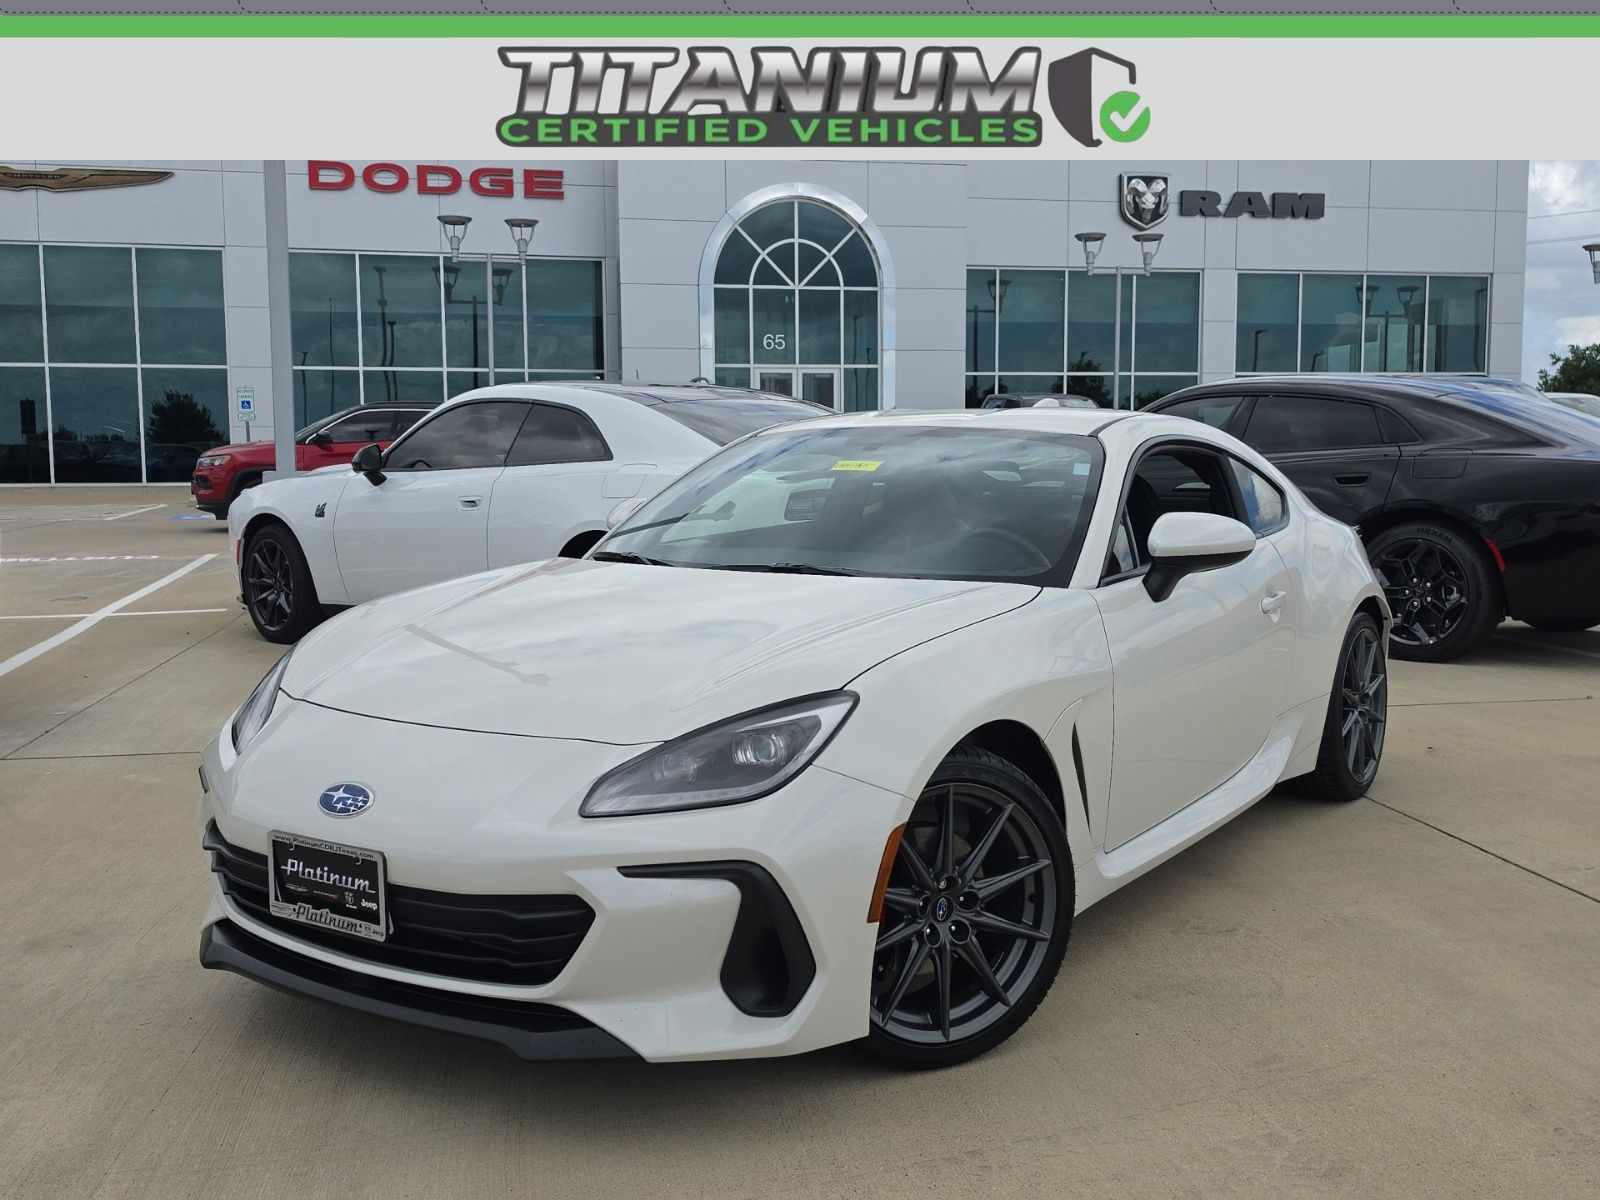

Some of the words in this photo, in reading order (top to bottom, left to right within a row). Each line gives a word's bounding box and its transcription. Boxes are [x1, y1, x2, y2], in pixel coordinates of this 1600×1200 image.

[308, 160, 565, 200] DODGE
[1179, 190, 1325, 218] RAM
[762, 333, 786, 350] 65
[280, 858, 376, 893] Platinum
[296, 904, 362, 934] Platinum
[361, 898, 378, 911] Jeep
